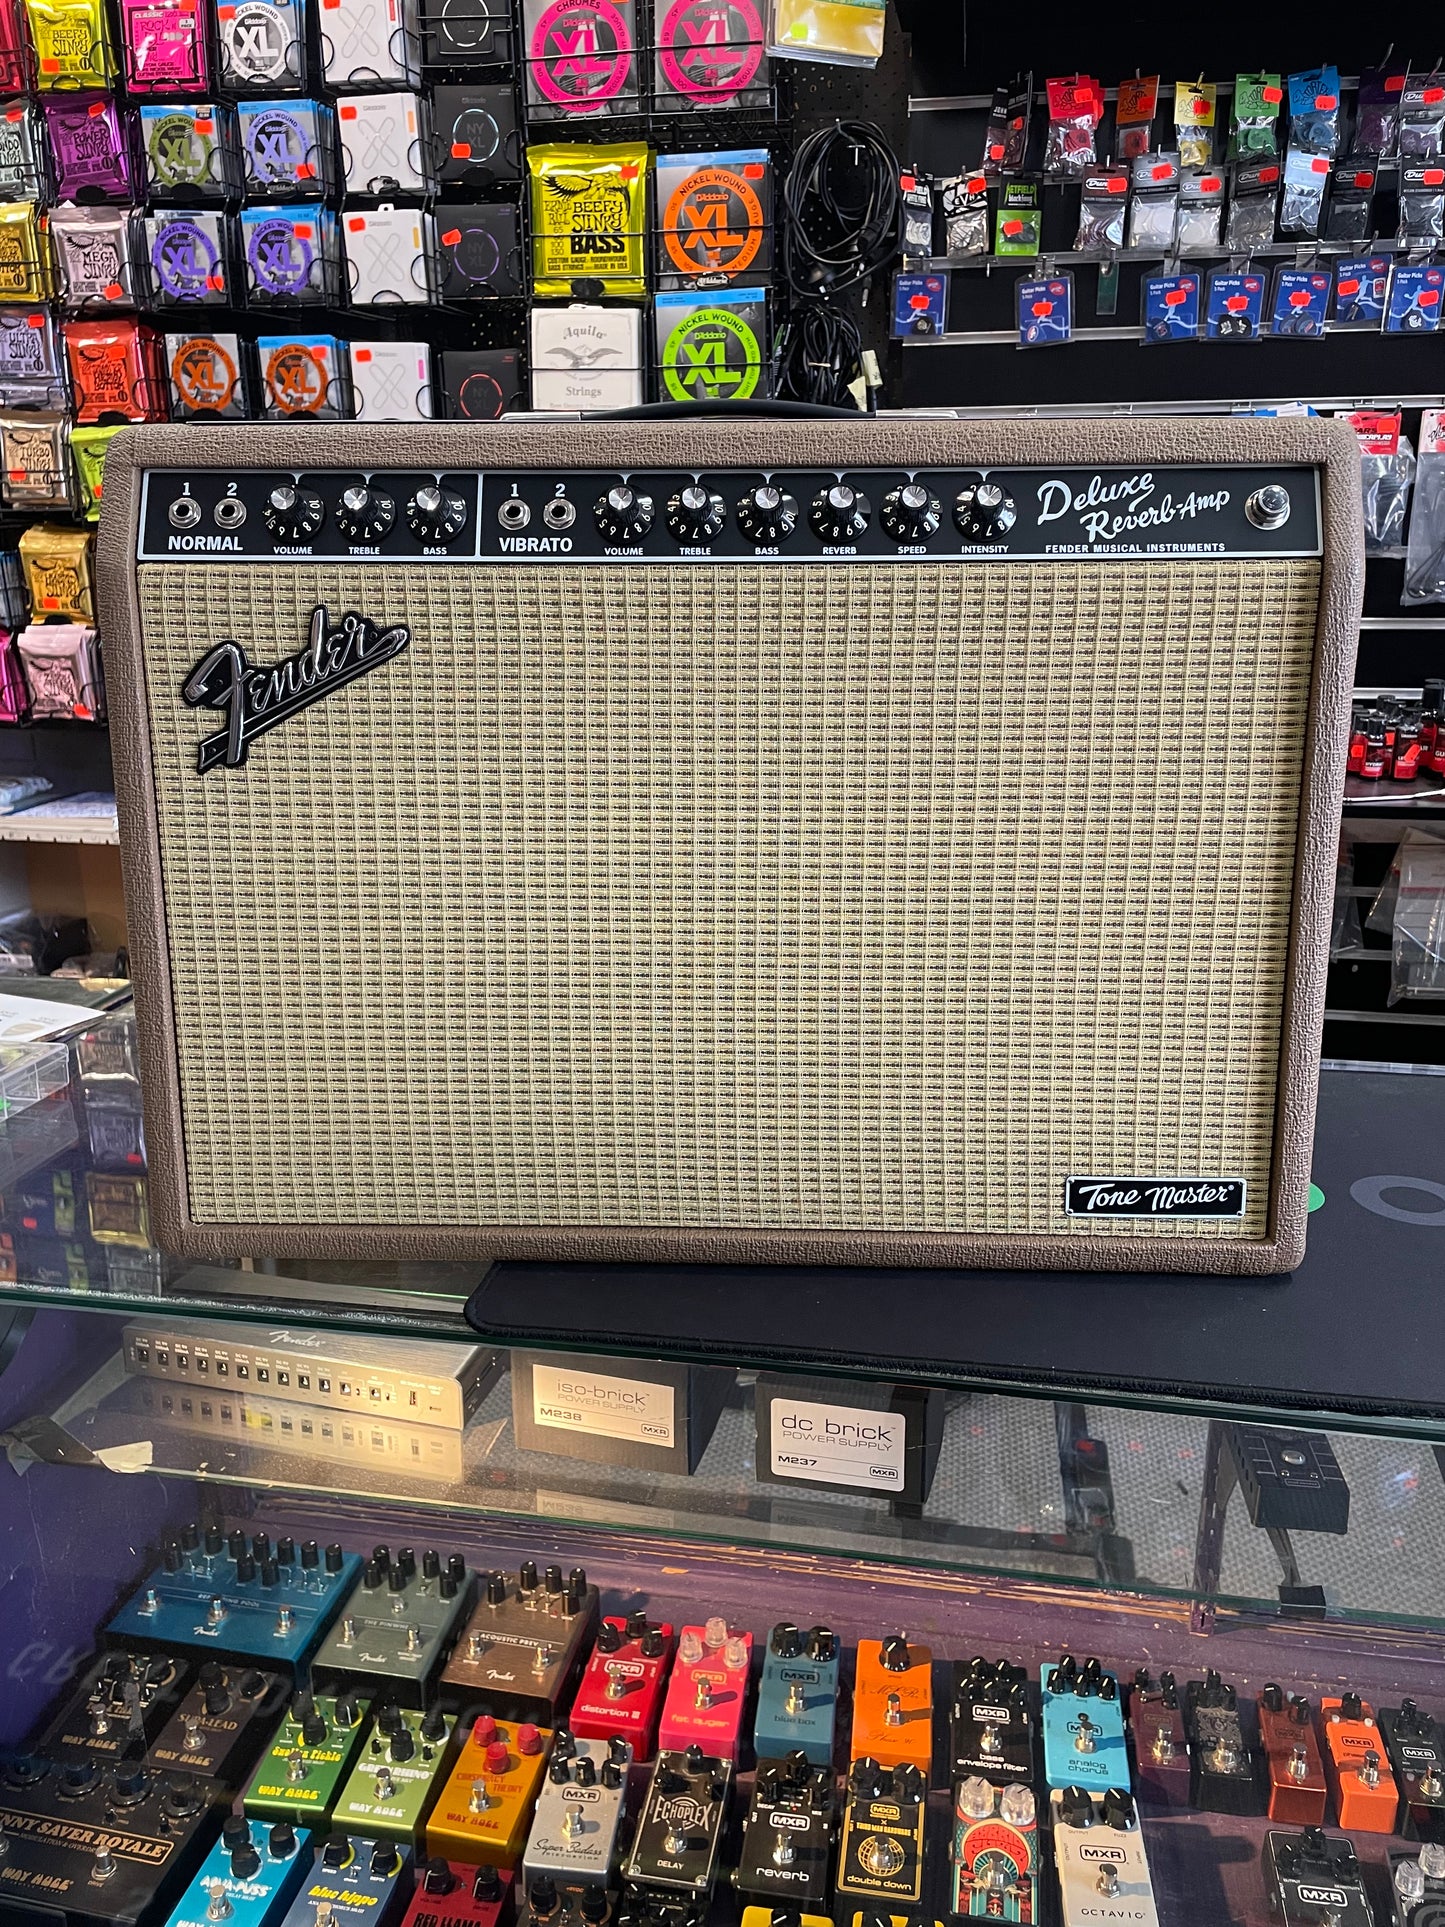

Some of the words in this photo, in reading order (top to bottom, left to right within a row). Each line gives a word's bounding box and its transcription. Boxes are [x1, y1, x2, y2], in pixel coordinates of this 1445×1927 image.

[254, 4, 279, 20] WOUND
[556, 0, 601, 13] CHROMES
[52, 28, 88, 40] BEEFY
[52, 39, 91, 57] SLINKY
[236, 25, 280, 58] XL
[680, 19, 743, 67] XL
[550, 30, 612, 76] XL
[156, 117, 176, 132] NICKEL
[253, 113, 273, 129] NICKEL
[275, 113, 298, 128] WOUND
[466, 123, 485, 134] NY
[72, 129, 109, 145] POWER
[468, 137, 486, 148] XL
[159, 138, 201, 167] XL
[257, 133, 299, 163] XL
[679, 174, 711, 197] NICKEL
[713, 174, 747, 195] WOUND
[573, 201, 623, 213] BEEFY
[256, 222, 276, 237] NICKEL
[572, 213, 624, 233] SLINKY
[683, 203, 744, 249] XL
[160, 226, 180, 242] NICKEL
[181, 224, 205, 240] WOUND
[571, 230, 625, 254] BASS
[83, 250, 117, 264] MEGA
[164, 246, 206, 276] XL
[260, 242, 301, 272] XL
[83, 261, 119, 280] SLINKY
[678, 313, 709, 336] NICKEL
[711, 313, 744, 334] WOUND
[563, 325, 605, 340] Aquila
[682, 342, 742, 385] XL
[186, 361, 225, 390] XL
[277, 366, 317, 394] XL
[565, 385, 602, 399] Strings
[182, 483, 191, 496] 1
[227, 483, 237, 496] 2
[511, 484, 520, 497] 1
[555, 484, 565, 497] 2
[1037, 473, 1155, 526] Deluxe
[1080, 490, 1230, 543] Reverb-Amp
[168, 536, 243, 551] NORMAL
[273, 546, 312, 555] VOLUME
[348, 546, 380, 555] TREBLE
[499, 537, 573, 552] VIBRATO
[822, 546, 857, 555] REVERB
[897, 546, 927, 555] SPEED
[961, 545, 1009, 554] INTENSITY
[1045, 544, 1089, 554] FENDER
[1093, 544, 1142, 553] MUSICAL
[1147, 542, 1226, 552] INSTRUMENTS
[423, 547, 447, 555] BASS
[604, 547, 644, 556] VOLUME
[679, 547, 711, 556] TREBLE
[755, 547, 779, 555] BASS
[184, 606, 411, 773] Fender
[1079, 1183, 1141, 1210] Tone
[268, 1330, 326, 1348] Fender
[557, 1379, 648, 1407] iso-brick
[557, 1394, 600, 1408] POWER
[602, 1400, 646, 1414] SUPPLY
[540, 1407, 582, 1422] M238
[643, 1425, 669, 1437] MXR
[782, 1414, 814, 1431] dc
[825, 1419, 893, 1442] brick
[783, 1430, 836, 1444] POWER
[838, 1438, 893, 1452] SUPPLY
[778, 1455, 818, 1467] M237
[872, 1467, 897, 1479] MXR
[480, 1633, 518, 1645] ACOUSTIC
[486, 1669, 516, 1681] Fender
[694, 1672, 724, 1682] MXR
[784, 1672, 816, 1682] MXR
[581, 1704, 630, 1718] distortion
[976, 1707, 1006, 1718] MXR
[774, 1715, 796, 1724] blue
[797, 1718, 816, 1726] box
[61, 1734, 84, 1745] WAY
[1345, 1737, 1371, 1747] MXR
[155, 1749, 180, 1761] WAY
[310, 1749, 342, 1762] Pickle
[979, 1753, 1005, 1763] bass
[1405, 1748, 1433, 1759] MXR
[957, 1758, 1002, 1771] envelope
[1003, 1761, 1028, 1772] filter
[1067, 1765, 1109, 1776] chorus
[1068, 1758, 1107, 1770] analog
[392, 1766, 430, 1780] RHINO
[258, 1785, 283, 1797] WAY
[285, 1788, 319, 1800] HUGE
[566, 1791, 598, 1801] MXR
[349, 1802, 373, 1814] WAY
[373, 1805, 404, 1818] HUGE
[652, 1795, 714, 1832] ECHOPLEX
[446, 1812, 469, 1823] WAY
[470, 1818, 499, 1829] HUGE
[772, 1815, 807, 1828] MXR
[0, 1813, 40, 1831] NNY
[37, 1822, 95, 1843] SAVER
[93, 1833, 166, 1858] ROYALE
[533, 1838, 565, 1857] Super
[568, 1841, 603, 1856] Badass
[1083, 1848, 1123, 1860] MXR
[657, 1859, 684, 1870] DELAY
[1, 1866, 32, 1882] WAY
[31, 1873, 70, 1891] HUGE
[756, 1867, 809, 1882] reverb
[847, 1875, 882, 1886] double
[884, 1881, 912, 1891] down
[308, 1885, 340, 1899] blue
[339, 1889, 379, 1907] hippo
[1302, 1889, 1343, 1903] MXR
[1401, 1895, 1425, 1904] OUTPUT
[1081, 1908, 1143, 1920] OCTAVIO
